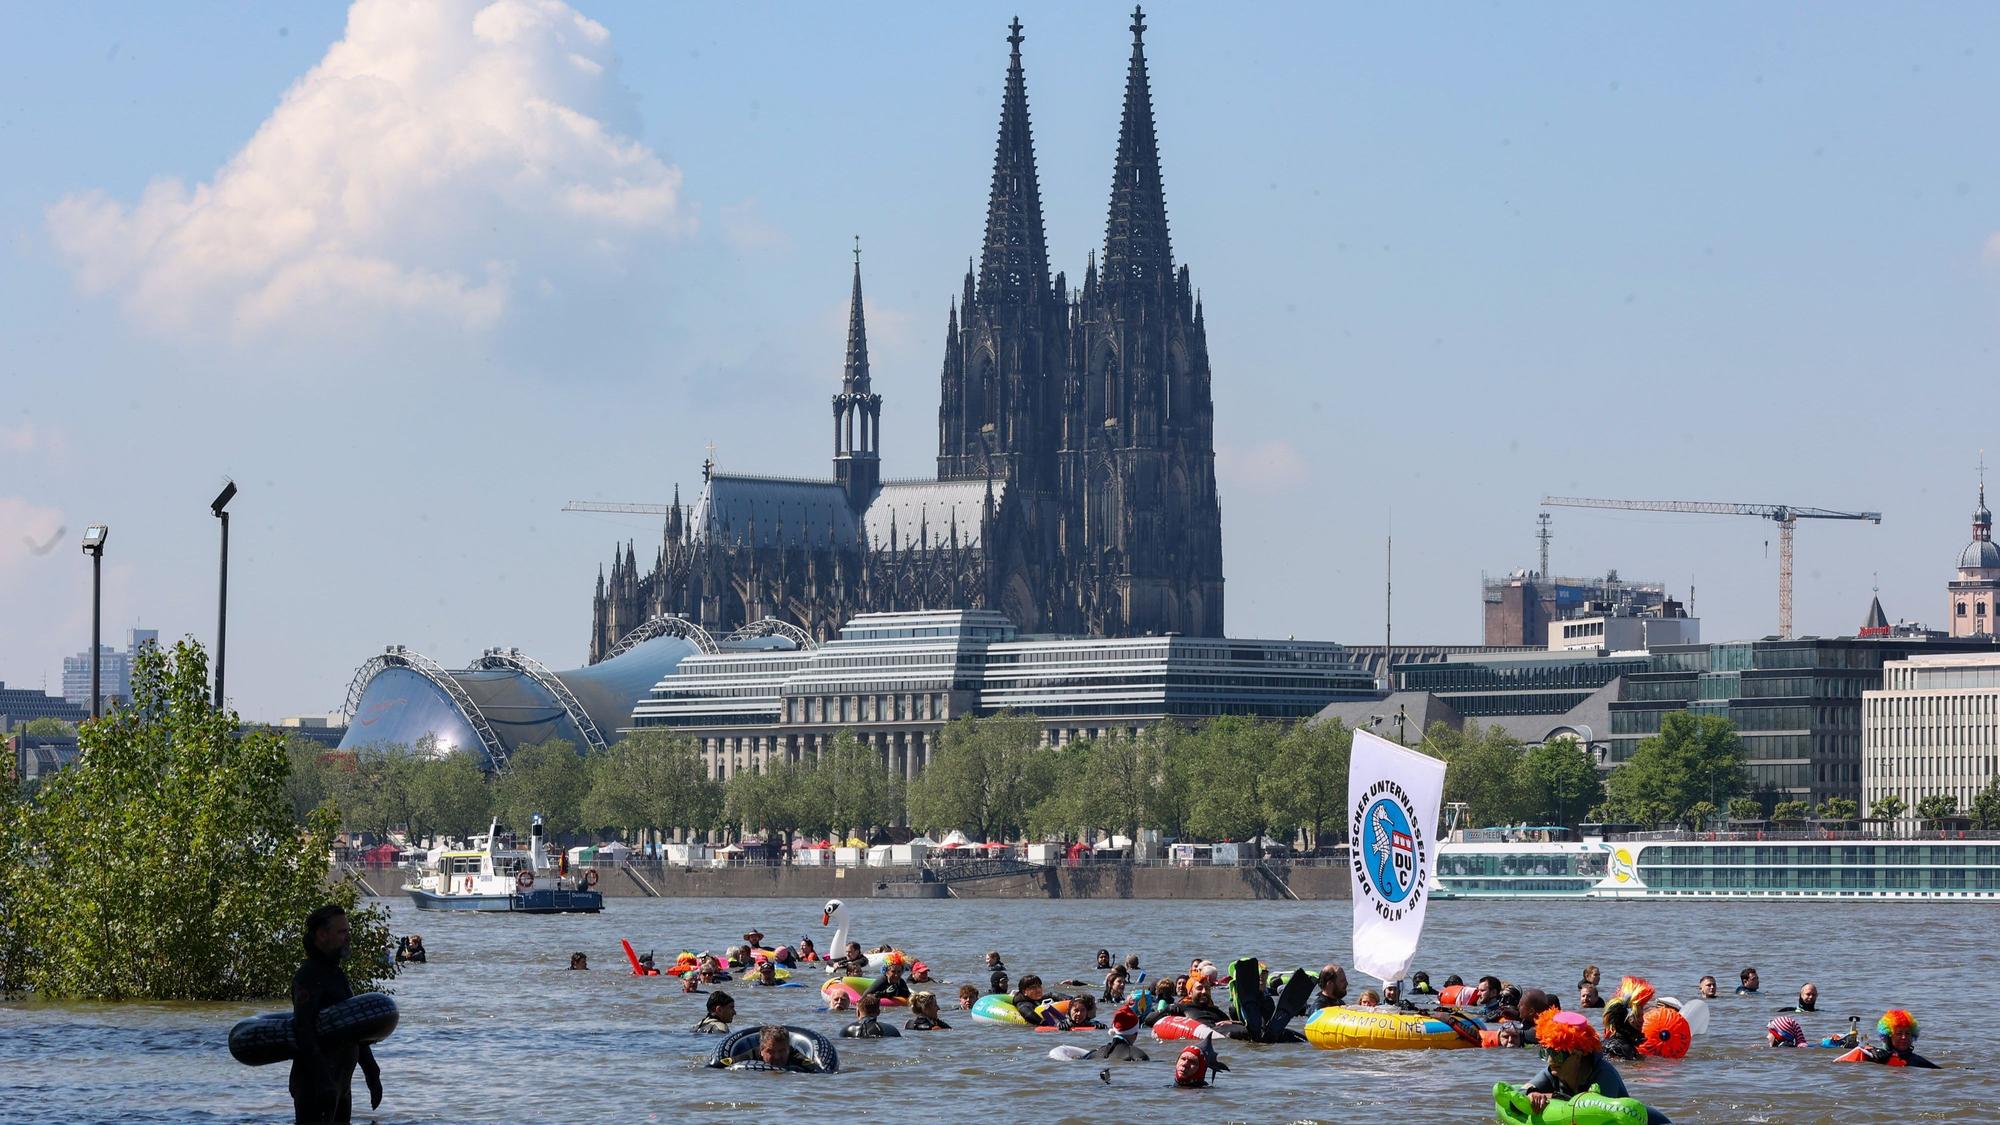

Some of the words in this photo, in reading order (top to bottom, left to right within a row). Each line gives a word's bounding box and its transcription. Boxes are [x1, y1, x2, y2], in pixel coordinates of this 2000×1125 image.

[1352, 792, 1371, 896] DEUTSCHER
[1370, 780, 1426, 863] UNTERWASSER
[1409, 869, 1426, 911] CLUB
[1395, 852, 1412, 871] DU
[1375, 900, 1402, 922] KÖLN
